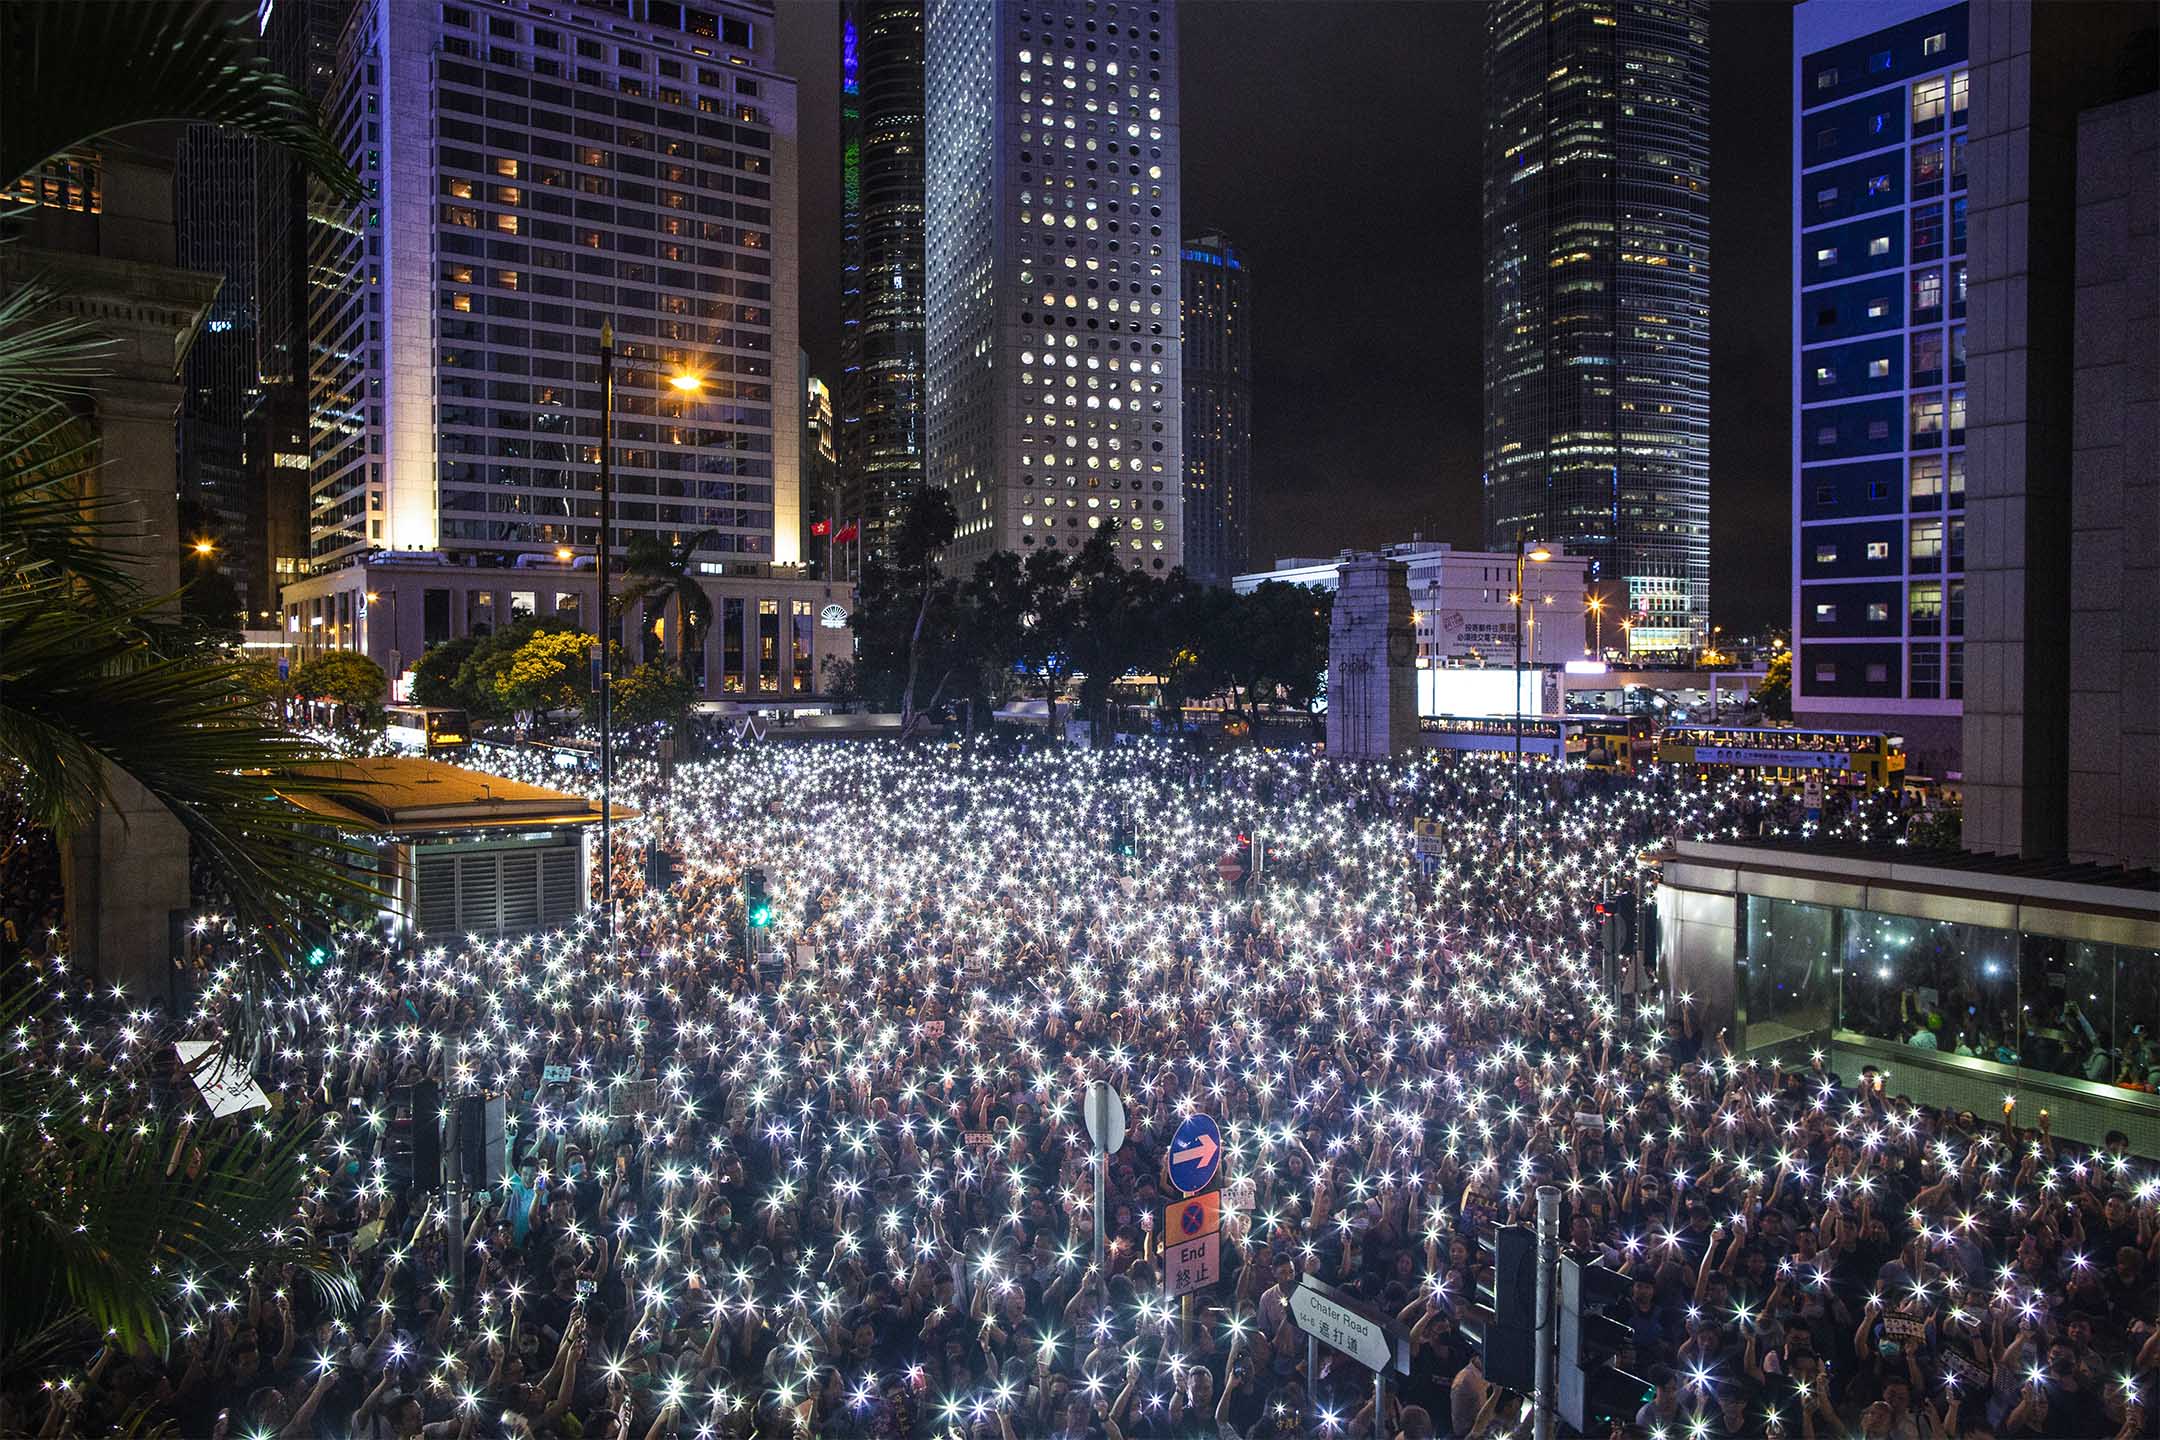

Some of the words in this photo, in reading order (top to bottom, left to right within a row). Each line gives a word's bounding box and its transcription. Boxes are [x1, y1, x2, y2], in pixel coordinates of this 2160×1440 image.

[1181, 1242, 1206, 1264] End
[1175, 1263, 1209, 1289] 終止
[1310, 1297, 1341, 1321] Chater
[1343, 1314, 1369, 1337] Road
[1319, 1320, 1359, 1355] 遮打道
